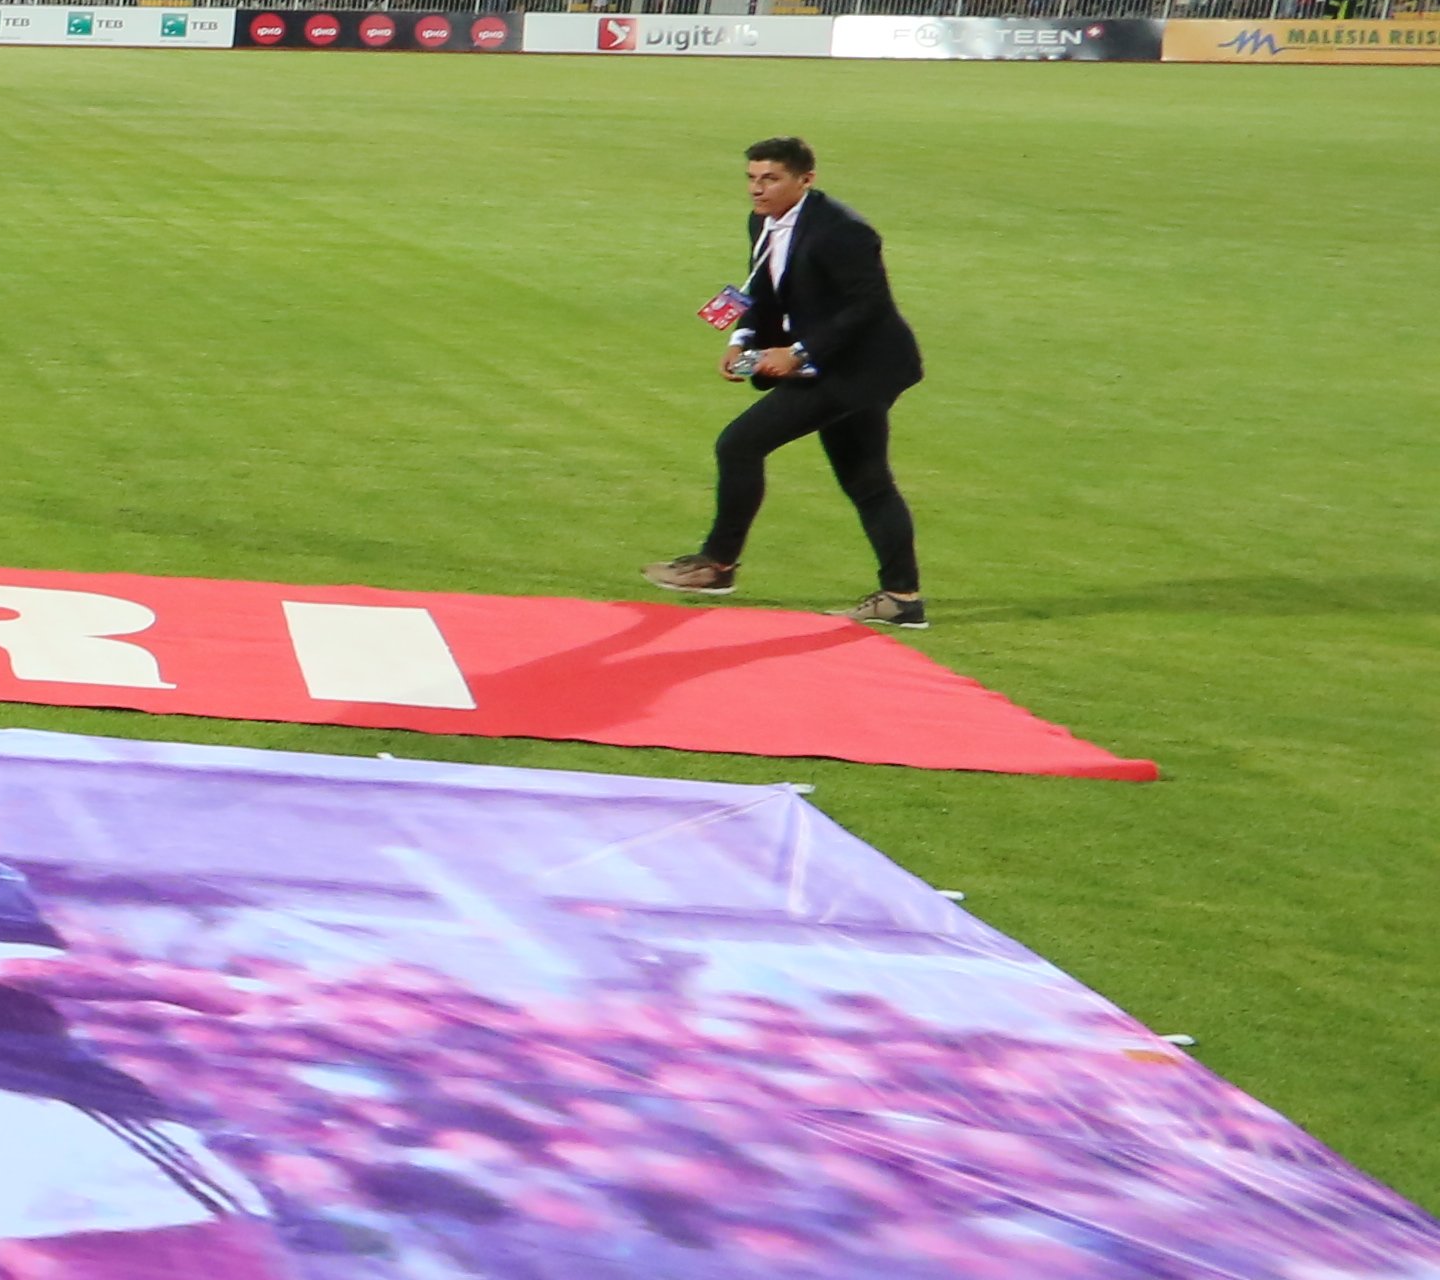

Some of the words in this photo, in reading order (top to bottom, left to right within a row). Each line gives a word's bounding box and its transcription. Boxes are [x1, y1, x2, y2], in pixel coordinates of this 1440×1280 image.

[4, 17, 30, 27] TEB
[96, 19, 123, 29] TEB
[191, 21, 218, 30] TEB
[893, 23, 1082, 47] FOUTEEN
[1390, 29, 1440, 45] REIS
